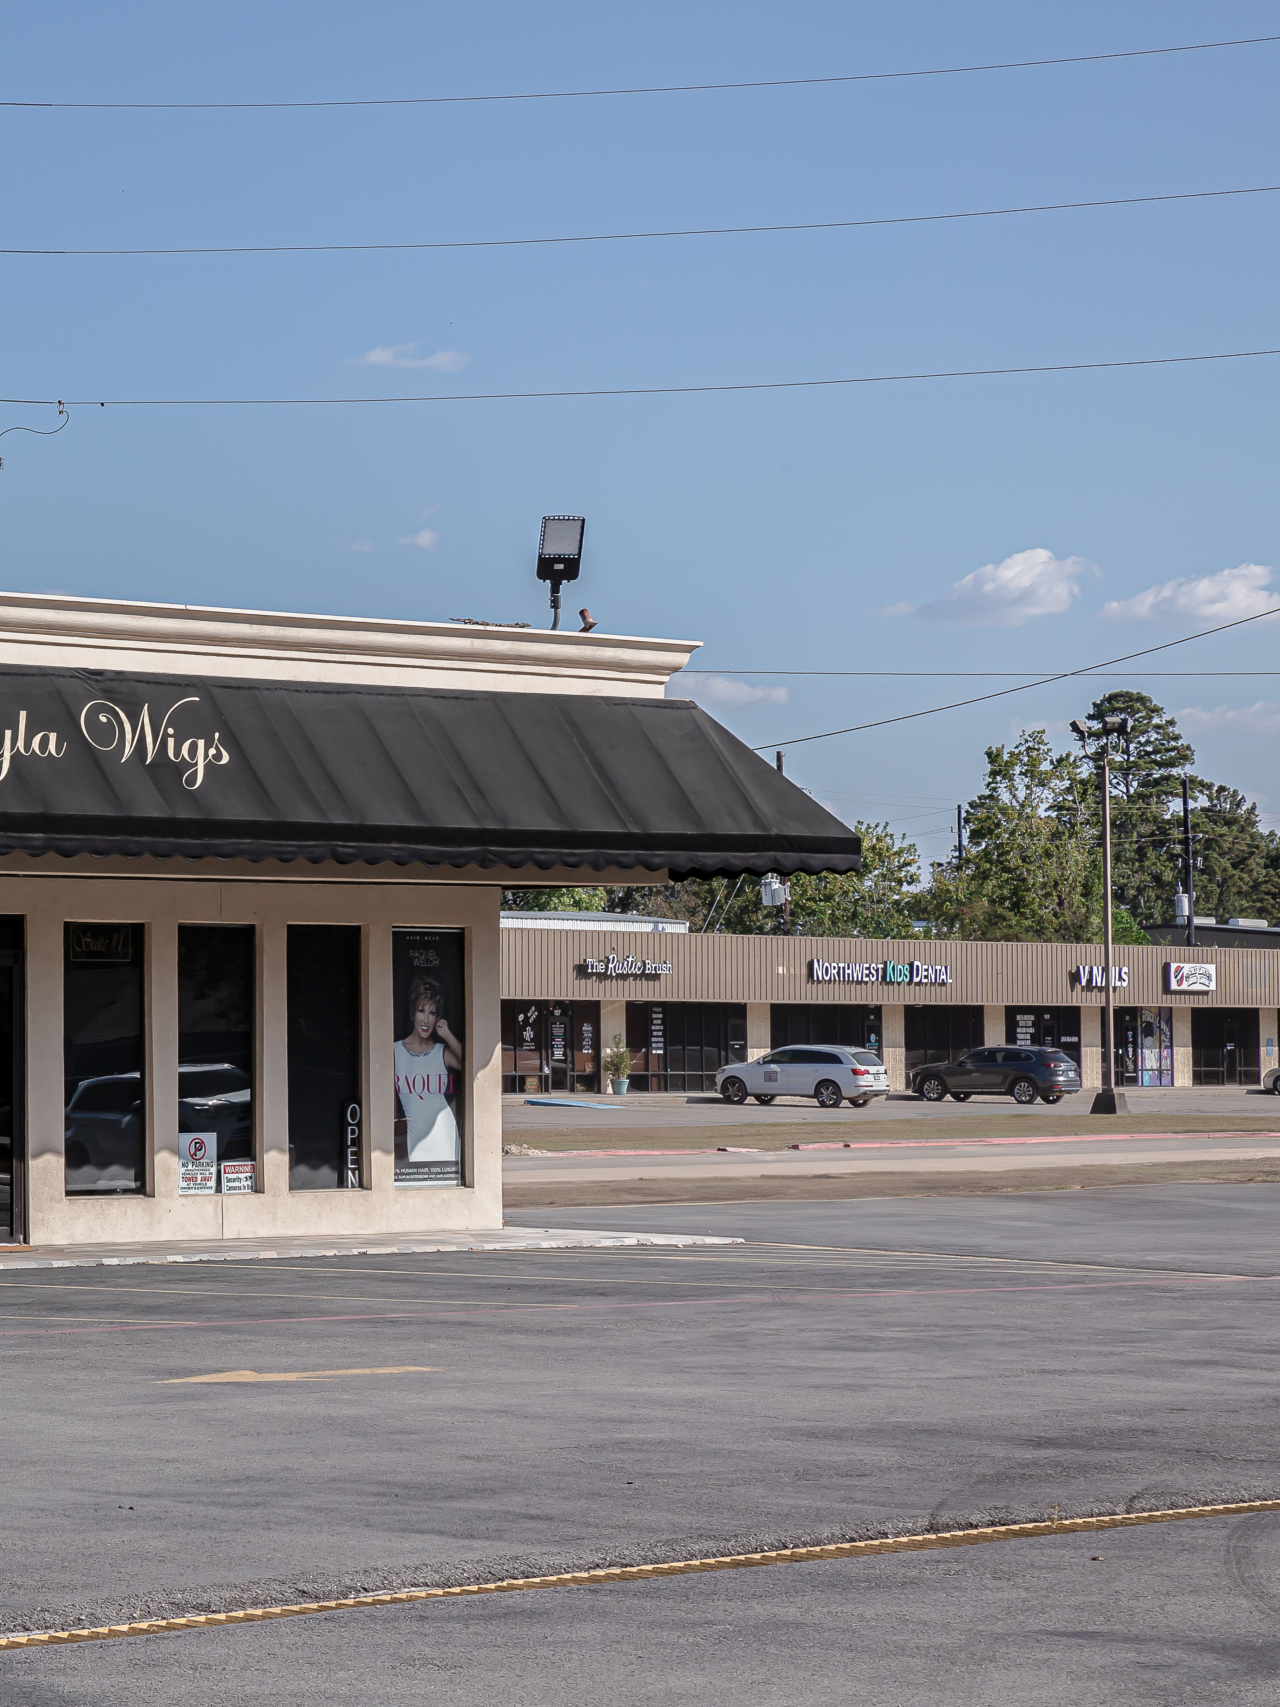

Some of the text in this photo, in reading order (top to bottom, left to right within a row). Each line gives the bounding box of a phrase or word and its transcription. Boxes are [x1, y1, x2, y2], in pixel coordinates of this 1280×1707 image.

[80, 697, 230, 790] Wigs
[409, 950, 438, 958] RAQUEL
[412, 958, 439, 967] WELCH
[586, 954, 672, 976] The Rustic Brush
[813, 958, 953, 983] NORTHWEST KIDS DENTAL
[1078, 965, 1089, 986] V
[346, 1104, 360, 1188] OPEN
